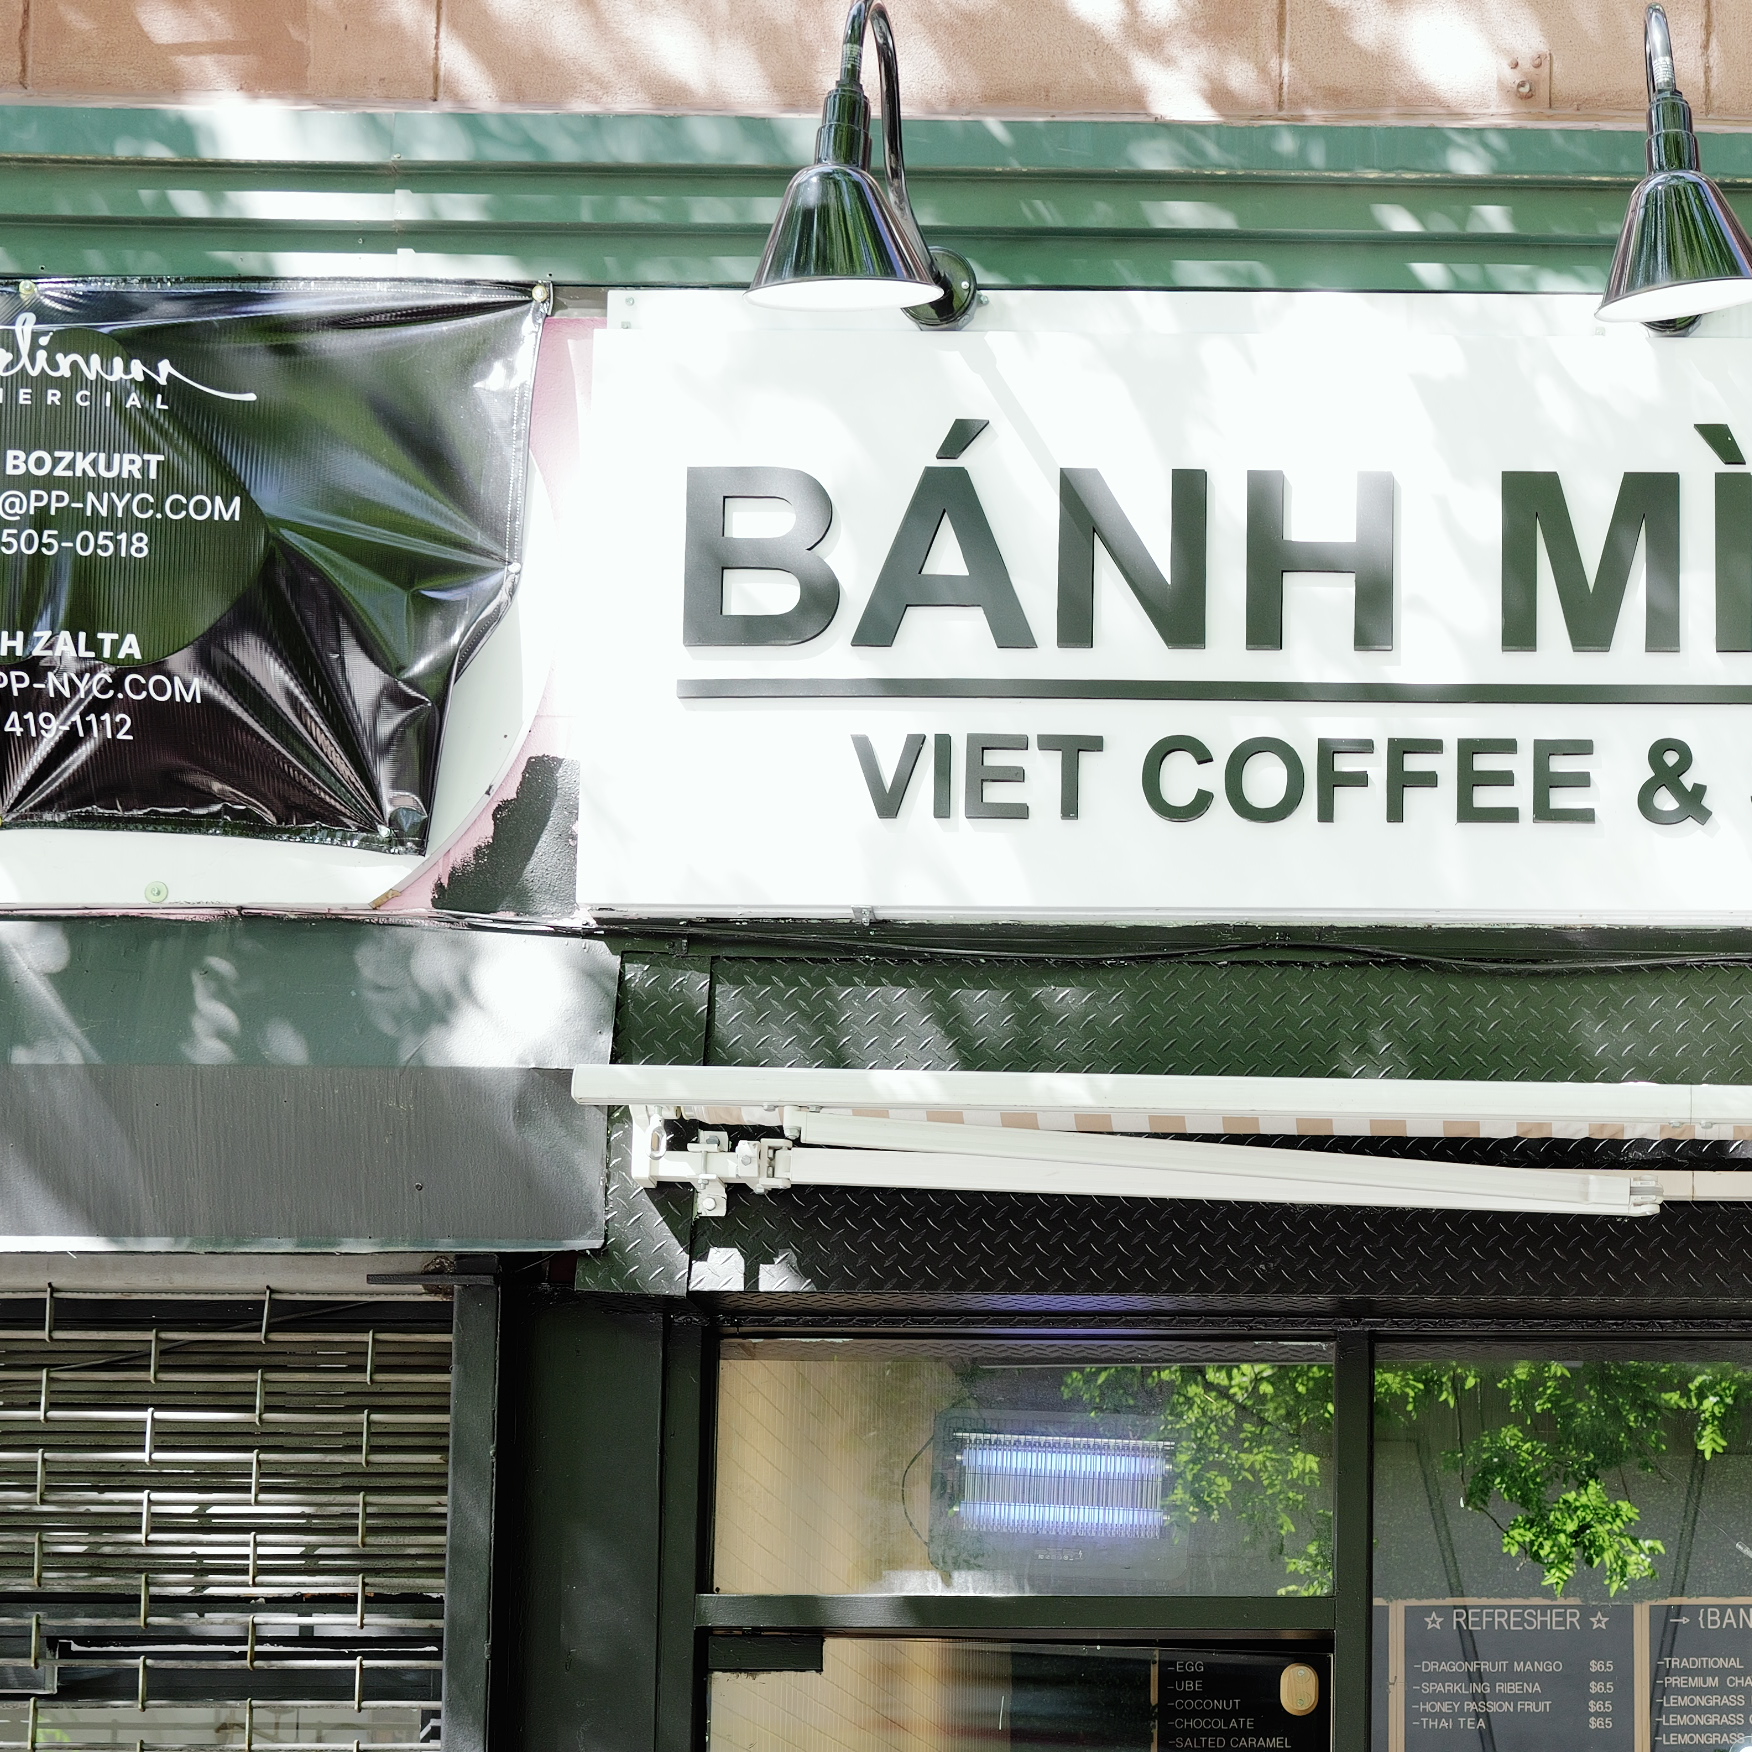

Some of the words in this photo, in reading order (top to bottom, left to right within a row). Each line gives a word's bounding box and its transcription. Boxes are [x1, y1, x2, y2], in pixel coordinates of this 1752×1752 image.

[0, 388, 169, 409] ERCIAL
[5, 449, 165, 480] BOZKURT
[0, 528, 149, 558] 505-0518
[683, 418, 1394, 652] BÁNH
[1502, 424, 1752, 653] MÌ
[31, 631, 142, 660] ZALTA
[4, 711, 134, 740] 419-1112
[850, 734, 1104, 820] VIET
[1141, 735, 1596, 824] COFFEE
[1637, 738, 1712, 825] &
[1453, 1609, 1581, 1630] REFRESHER
[1514, 1661, 1562, 1673] MANGO
[1589, 1659, 1614, 1673] $6.5
[1495, 1682, 1542, 1694] RIBENA
[1589, 1681, 1614, 1694] $6.5
[1464, 1701, 1513, 1713] PASSION
[1518, 1701, 1551, 1713] FRUIT
[1588, 1700, 1612, 1713] $6.5
[1458, 1718, 1486, 1729] TEA
[1230, 1737, 1292, 1748] CARAMEL
